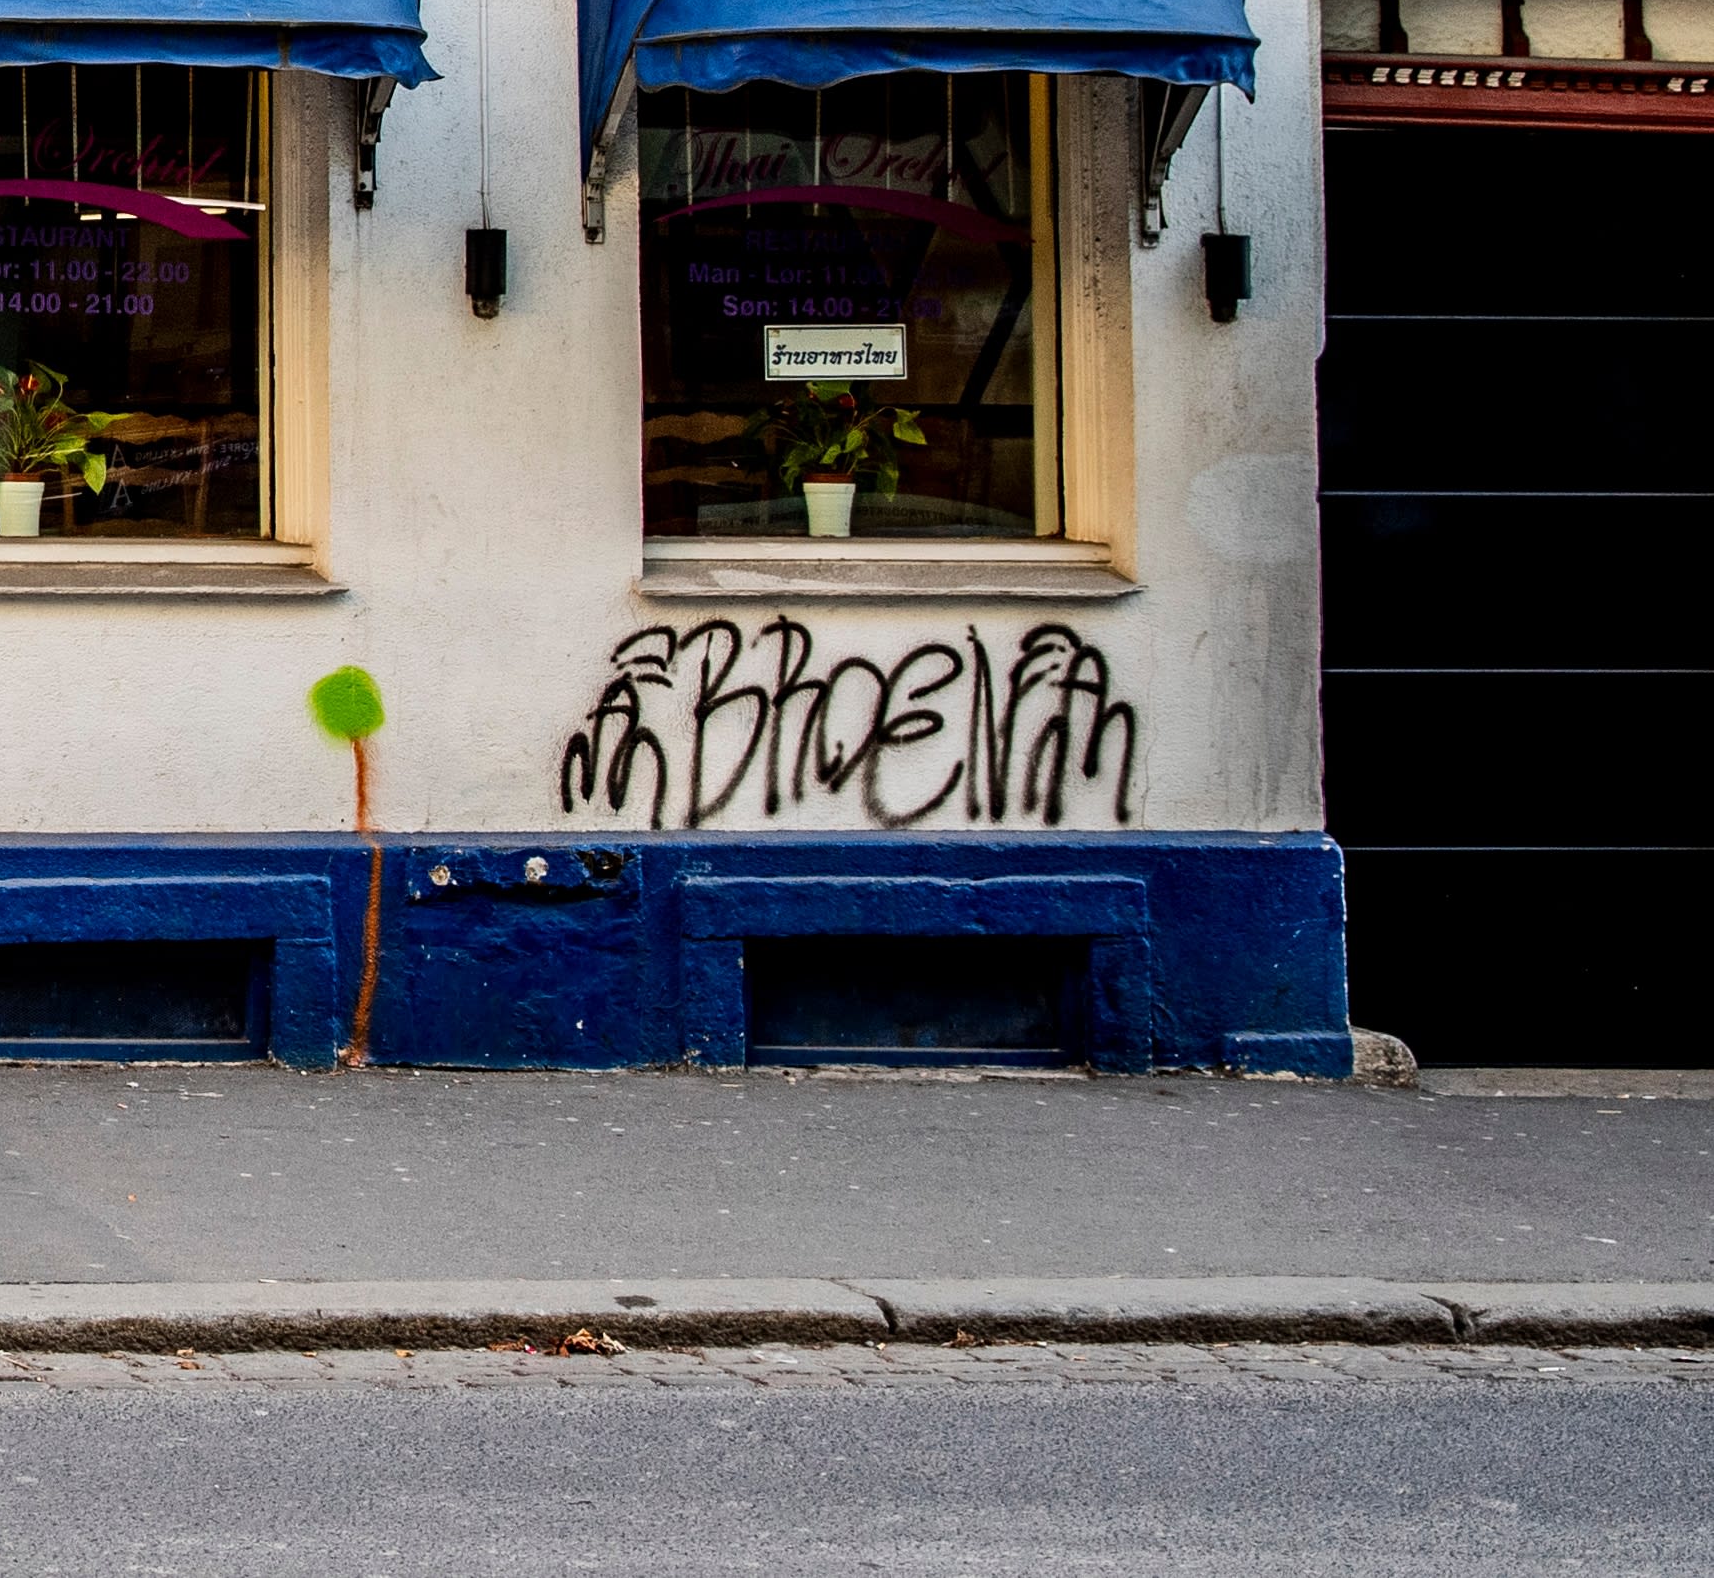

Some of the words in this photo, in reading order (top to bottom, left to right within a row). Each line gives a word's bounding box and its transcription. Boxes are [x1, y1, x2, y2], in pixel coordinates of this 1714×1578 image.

[29, 259, 99, 283] 11.00
[121, 260, 191, 284] 22.00
[688, 262, 741, 285] Man
[85, 292, 154, 317] 21.00
[722, 294, 779, 318] Søn:
[788, 296, 854, 319] 14.00
[771, 342, 899, 366] ร้านอาหารไทย
